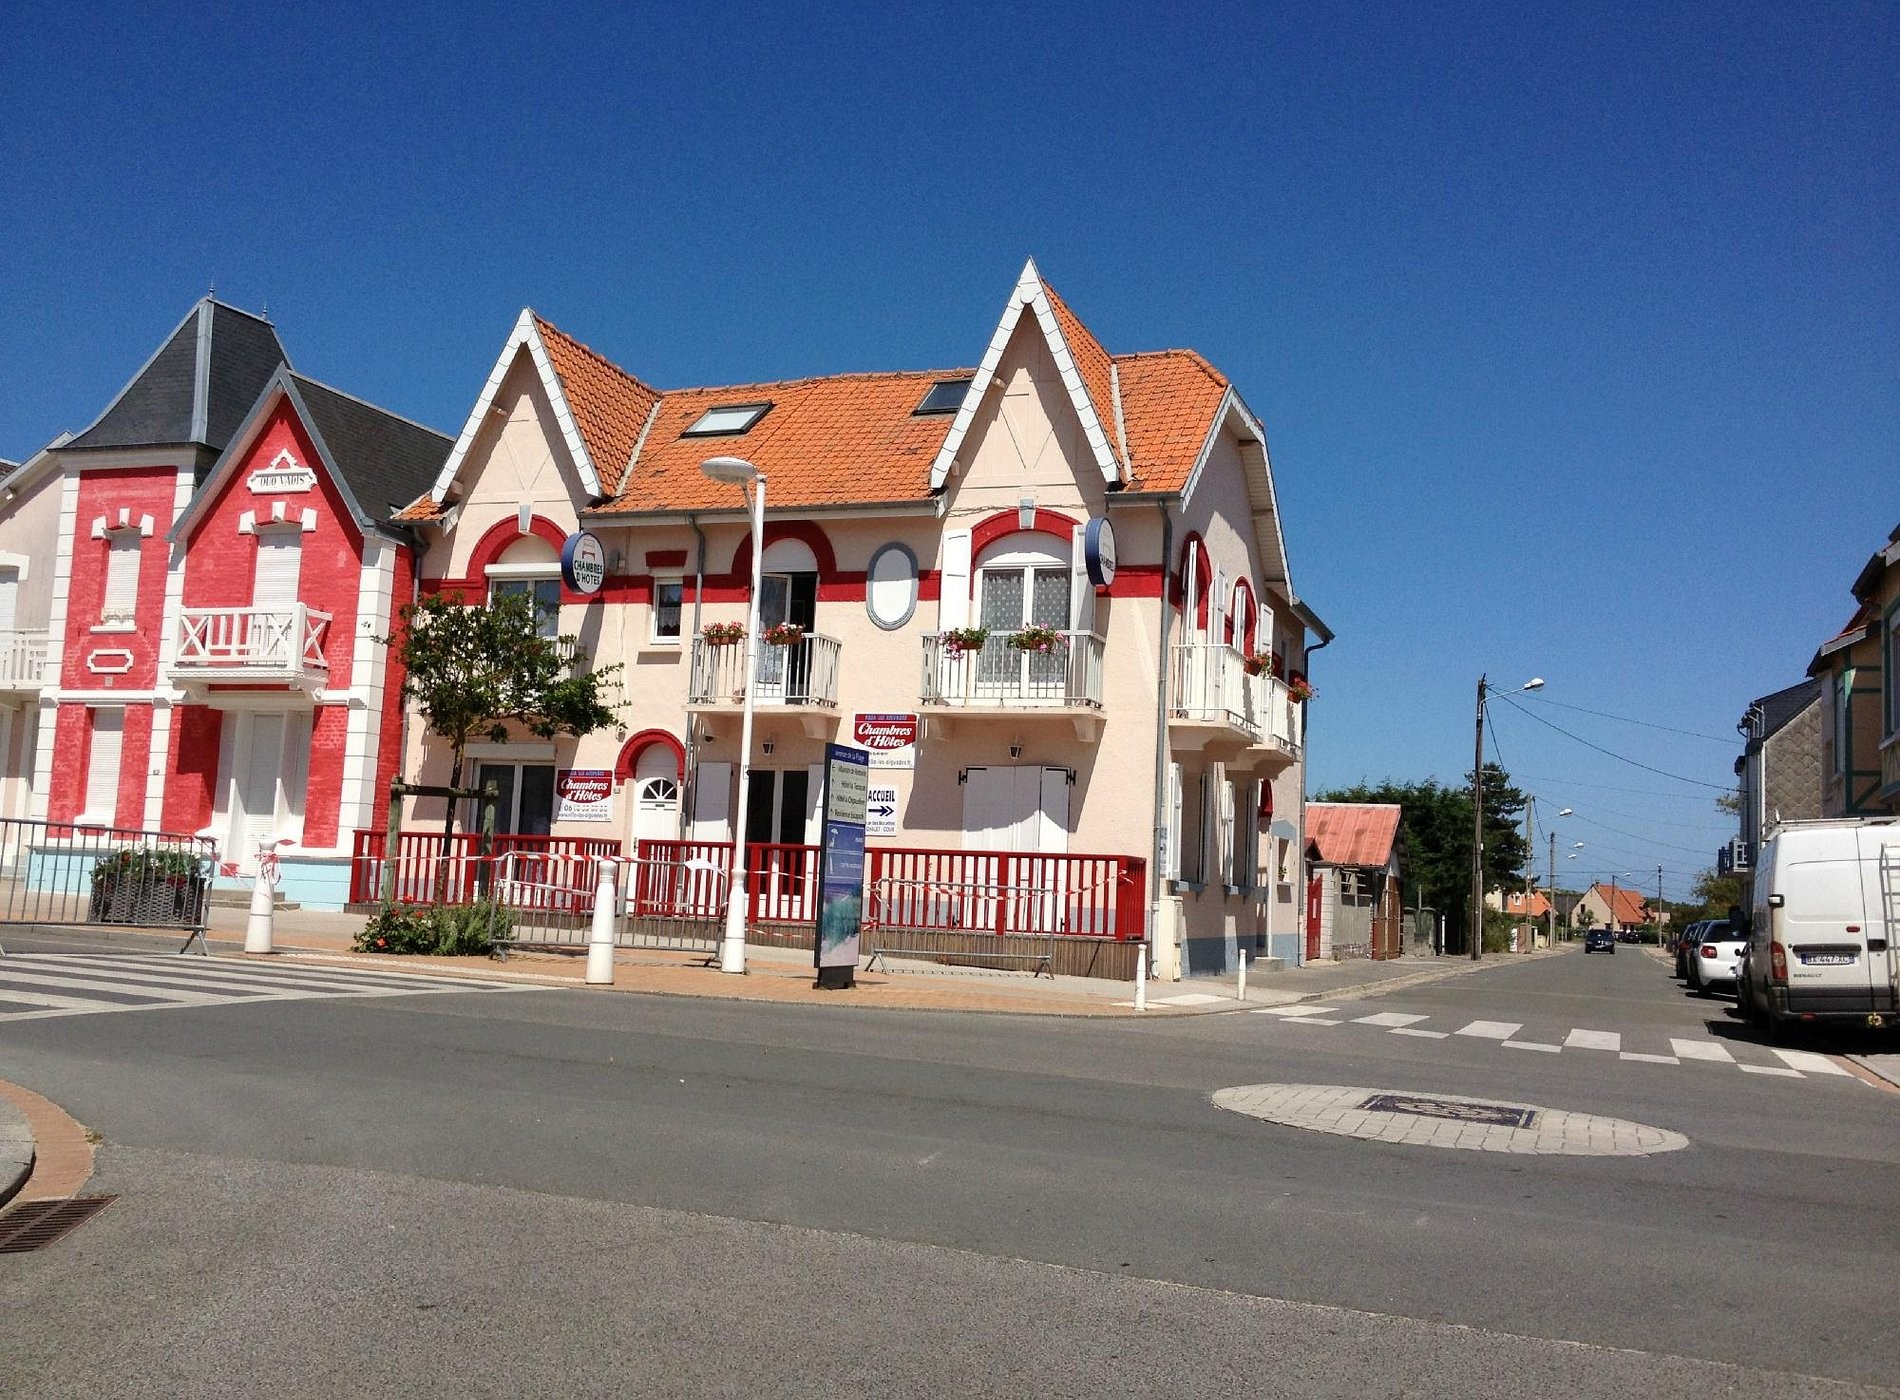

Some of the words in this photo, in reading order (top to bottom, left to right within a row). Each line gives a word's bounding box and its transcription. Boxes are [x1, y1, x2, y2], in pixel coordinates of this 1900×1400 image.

[574, 560, 602, 574] CHAMBRES
[858, 722, 912, 736] Chambres
[864, 735, 906, 747] d'Hôtes
[560, 778, 609, 791] Chambres
[565, 790, 603, 801] d'Hôtes
[868, 789, 895, 802] ACCUEIL
